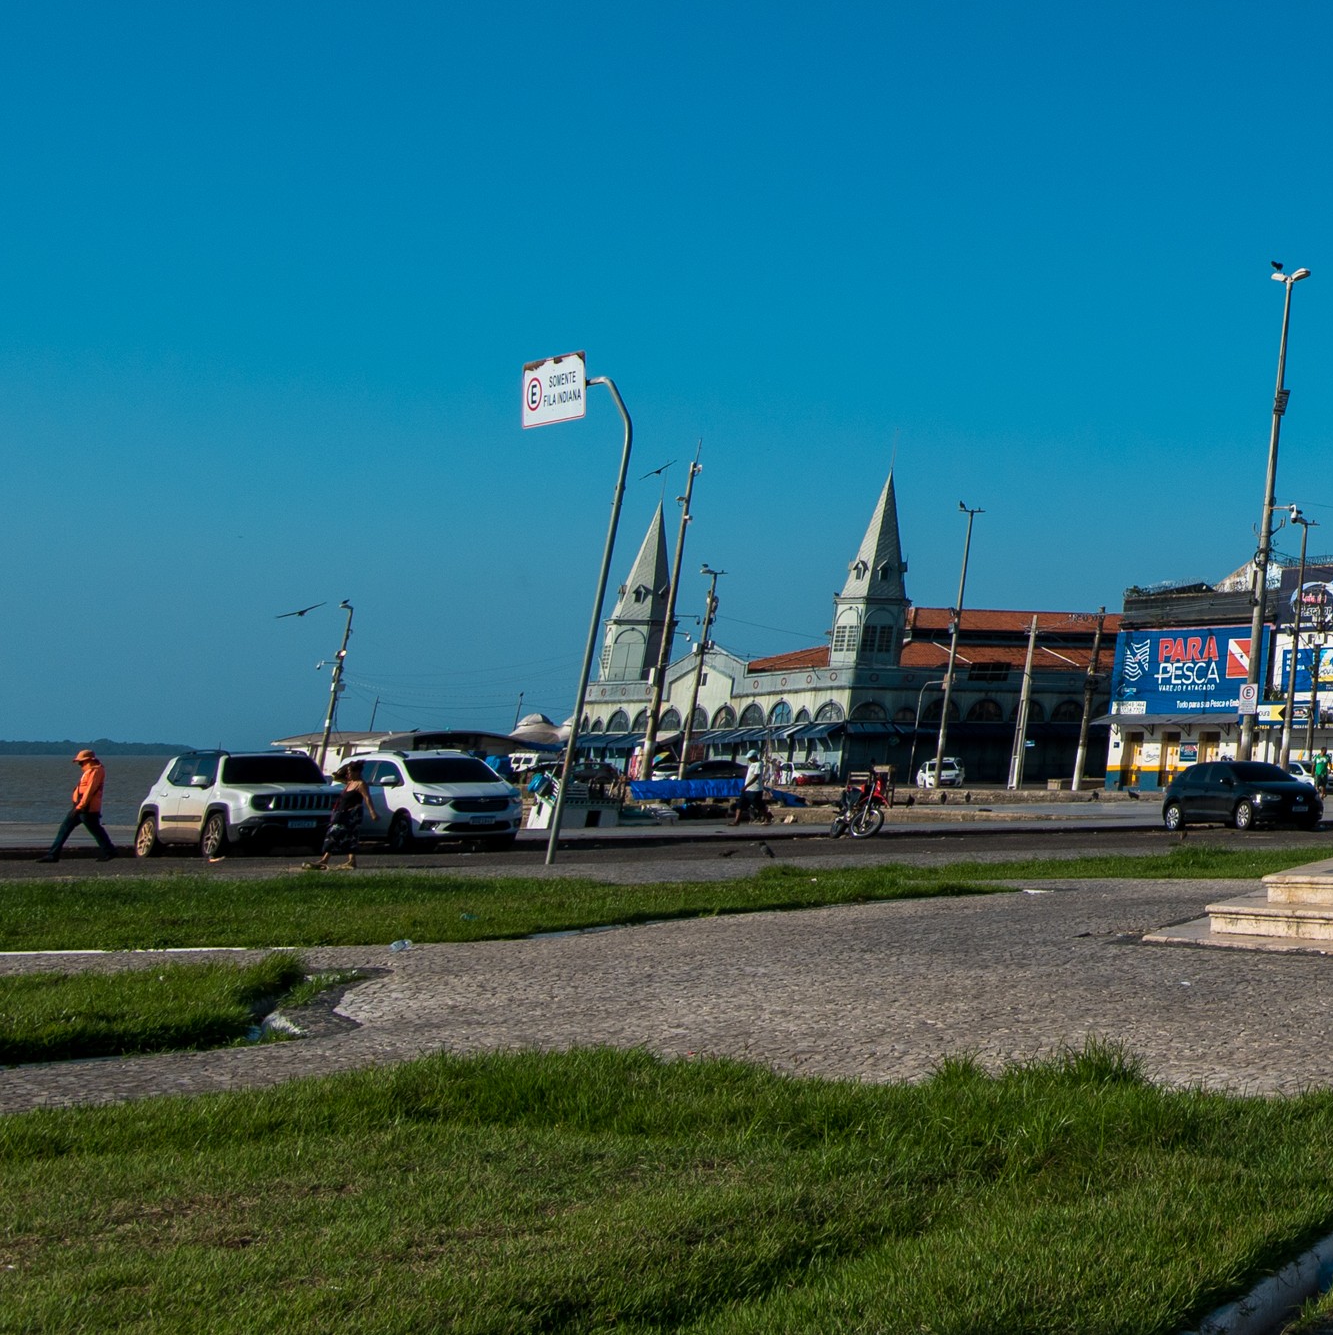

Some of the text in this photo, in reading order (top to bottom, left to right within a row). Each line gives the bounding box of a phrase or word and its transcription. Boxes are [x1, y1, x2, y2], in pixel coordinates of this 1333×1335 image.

[548, 370, 577, 388] SOMENTE
[530, 384, 538, 405] E
[543, 387, 582, 408] FILA INDIANA
[1158, 635, 1219, 663] PARA
[1154, 661, 1220, 684] PESCA
[1158, 684, 1182, 692] VAREJO
